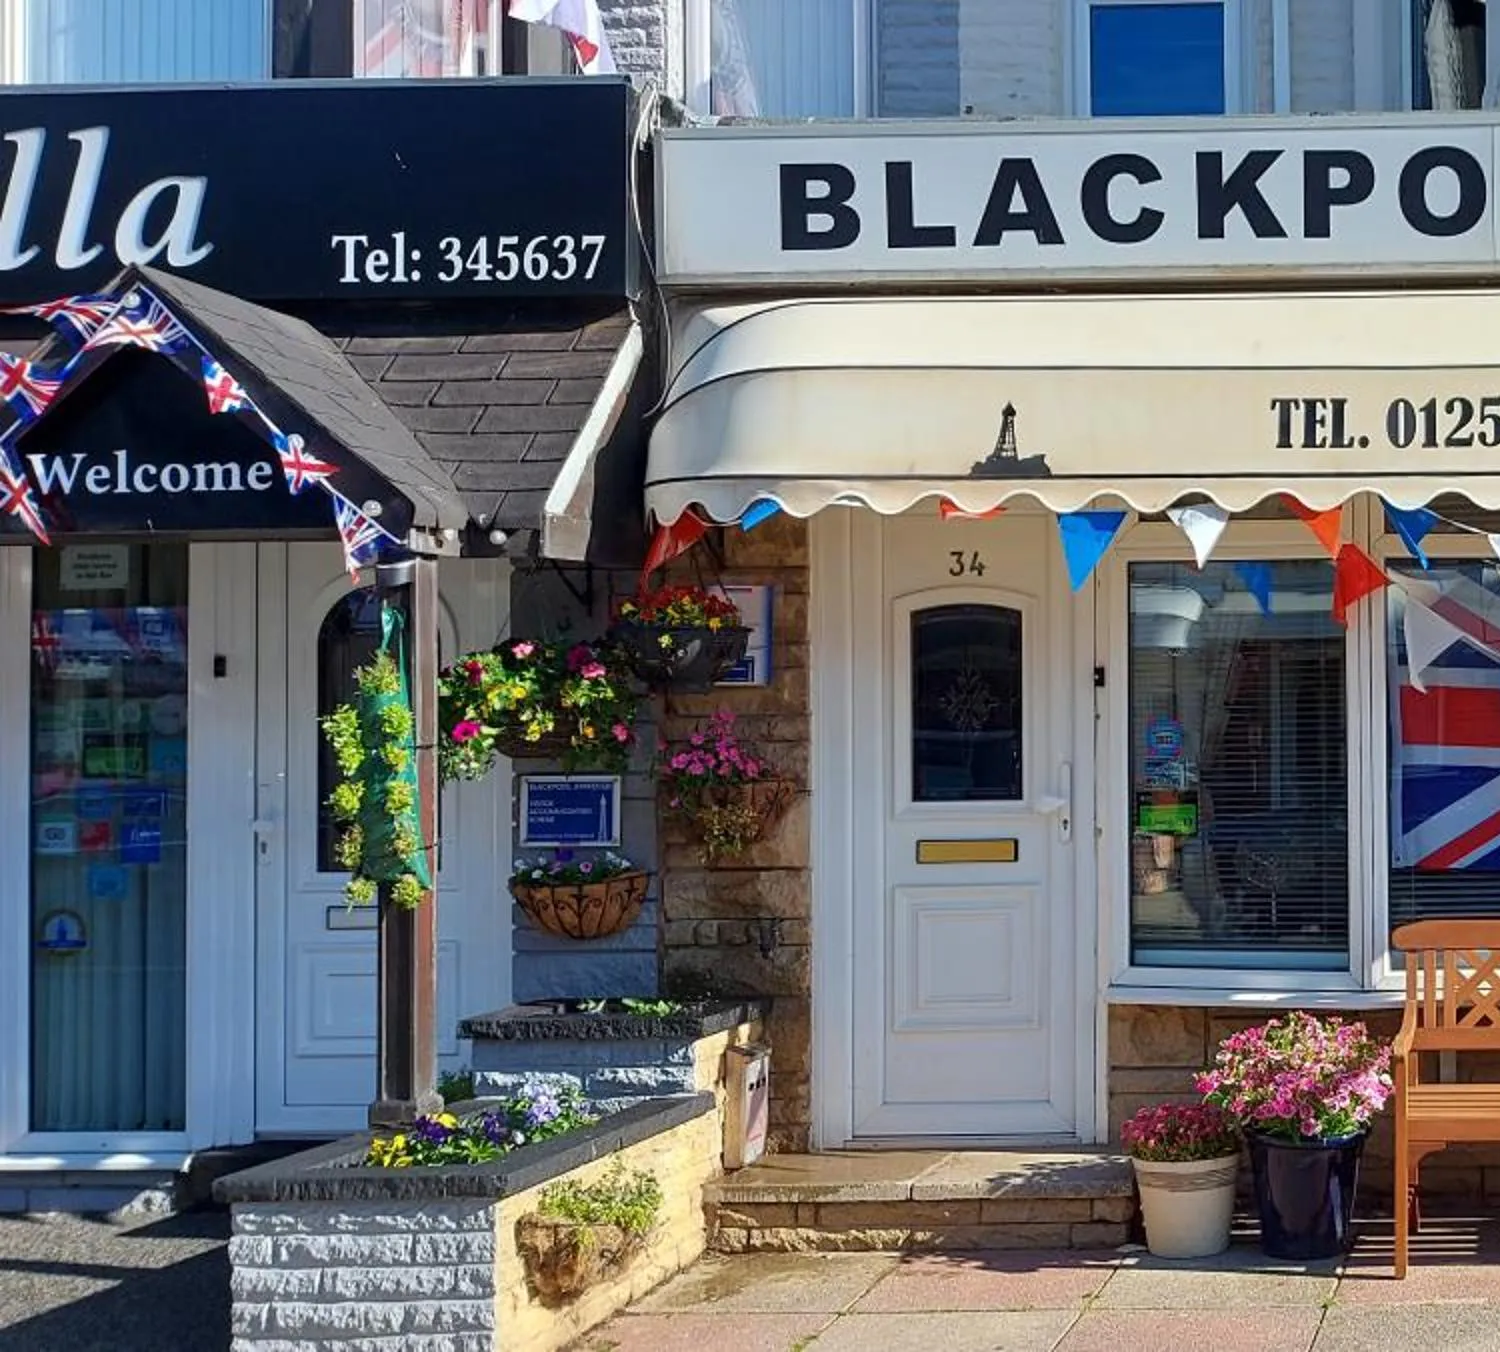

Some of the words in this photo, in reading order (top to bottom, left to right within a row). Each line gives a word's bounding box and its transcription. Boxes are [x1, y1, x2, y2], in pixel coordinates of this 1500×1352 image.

[331, 232, 422, 283] Tel:
[437, 234, 606, 283] 345637
[1270, 398, 1370, 449] TEL.
[26, 449, 273, 495] Welcome
[949, 551, 986, 577] 34
